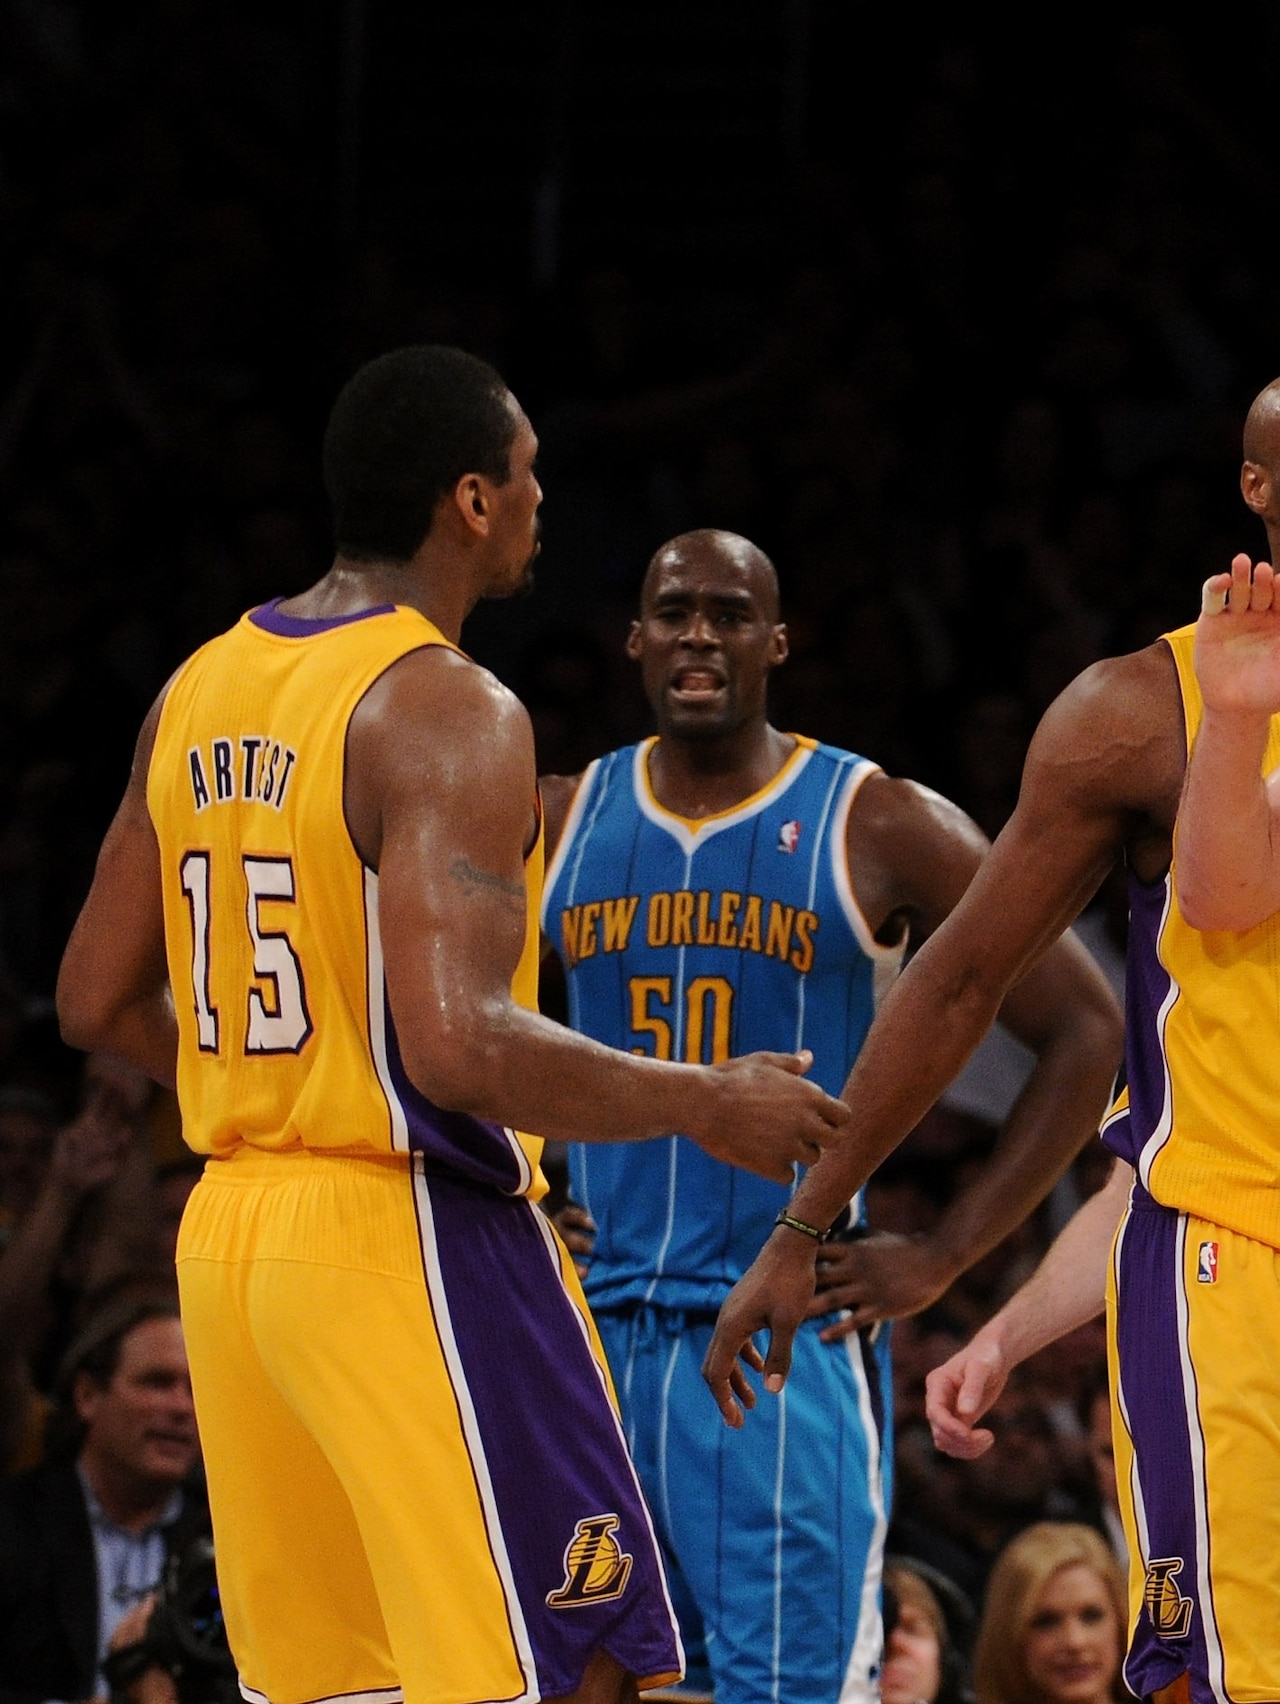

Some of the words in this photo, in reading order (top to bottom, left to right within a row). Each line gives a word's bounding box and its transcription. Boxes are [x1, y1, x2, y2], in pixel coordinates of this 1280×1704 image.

[180, 850, 314, 1055] 15
[560, 895, 640, 970] NEW
[646, 889, 820, 974] ORLEANS
[627, 975, 736, 1066] 50
